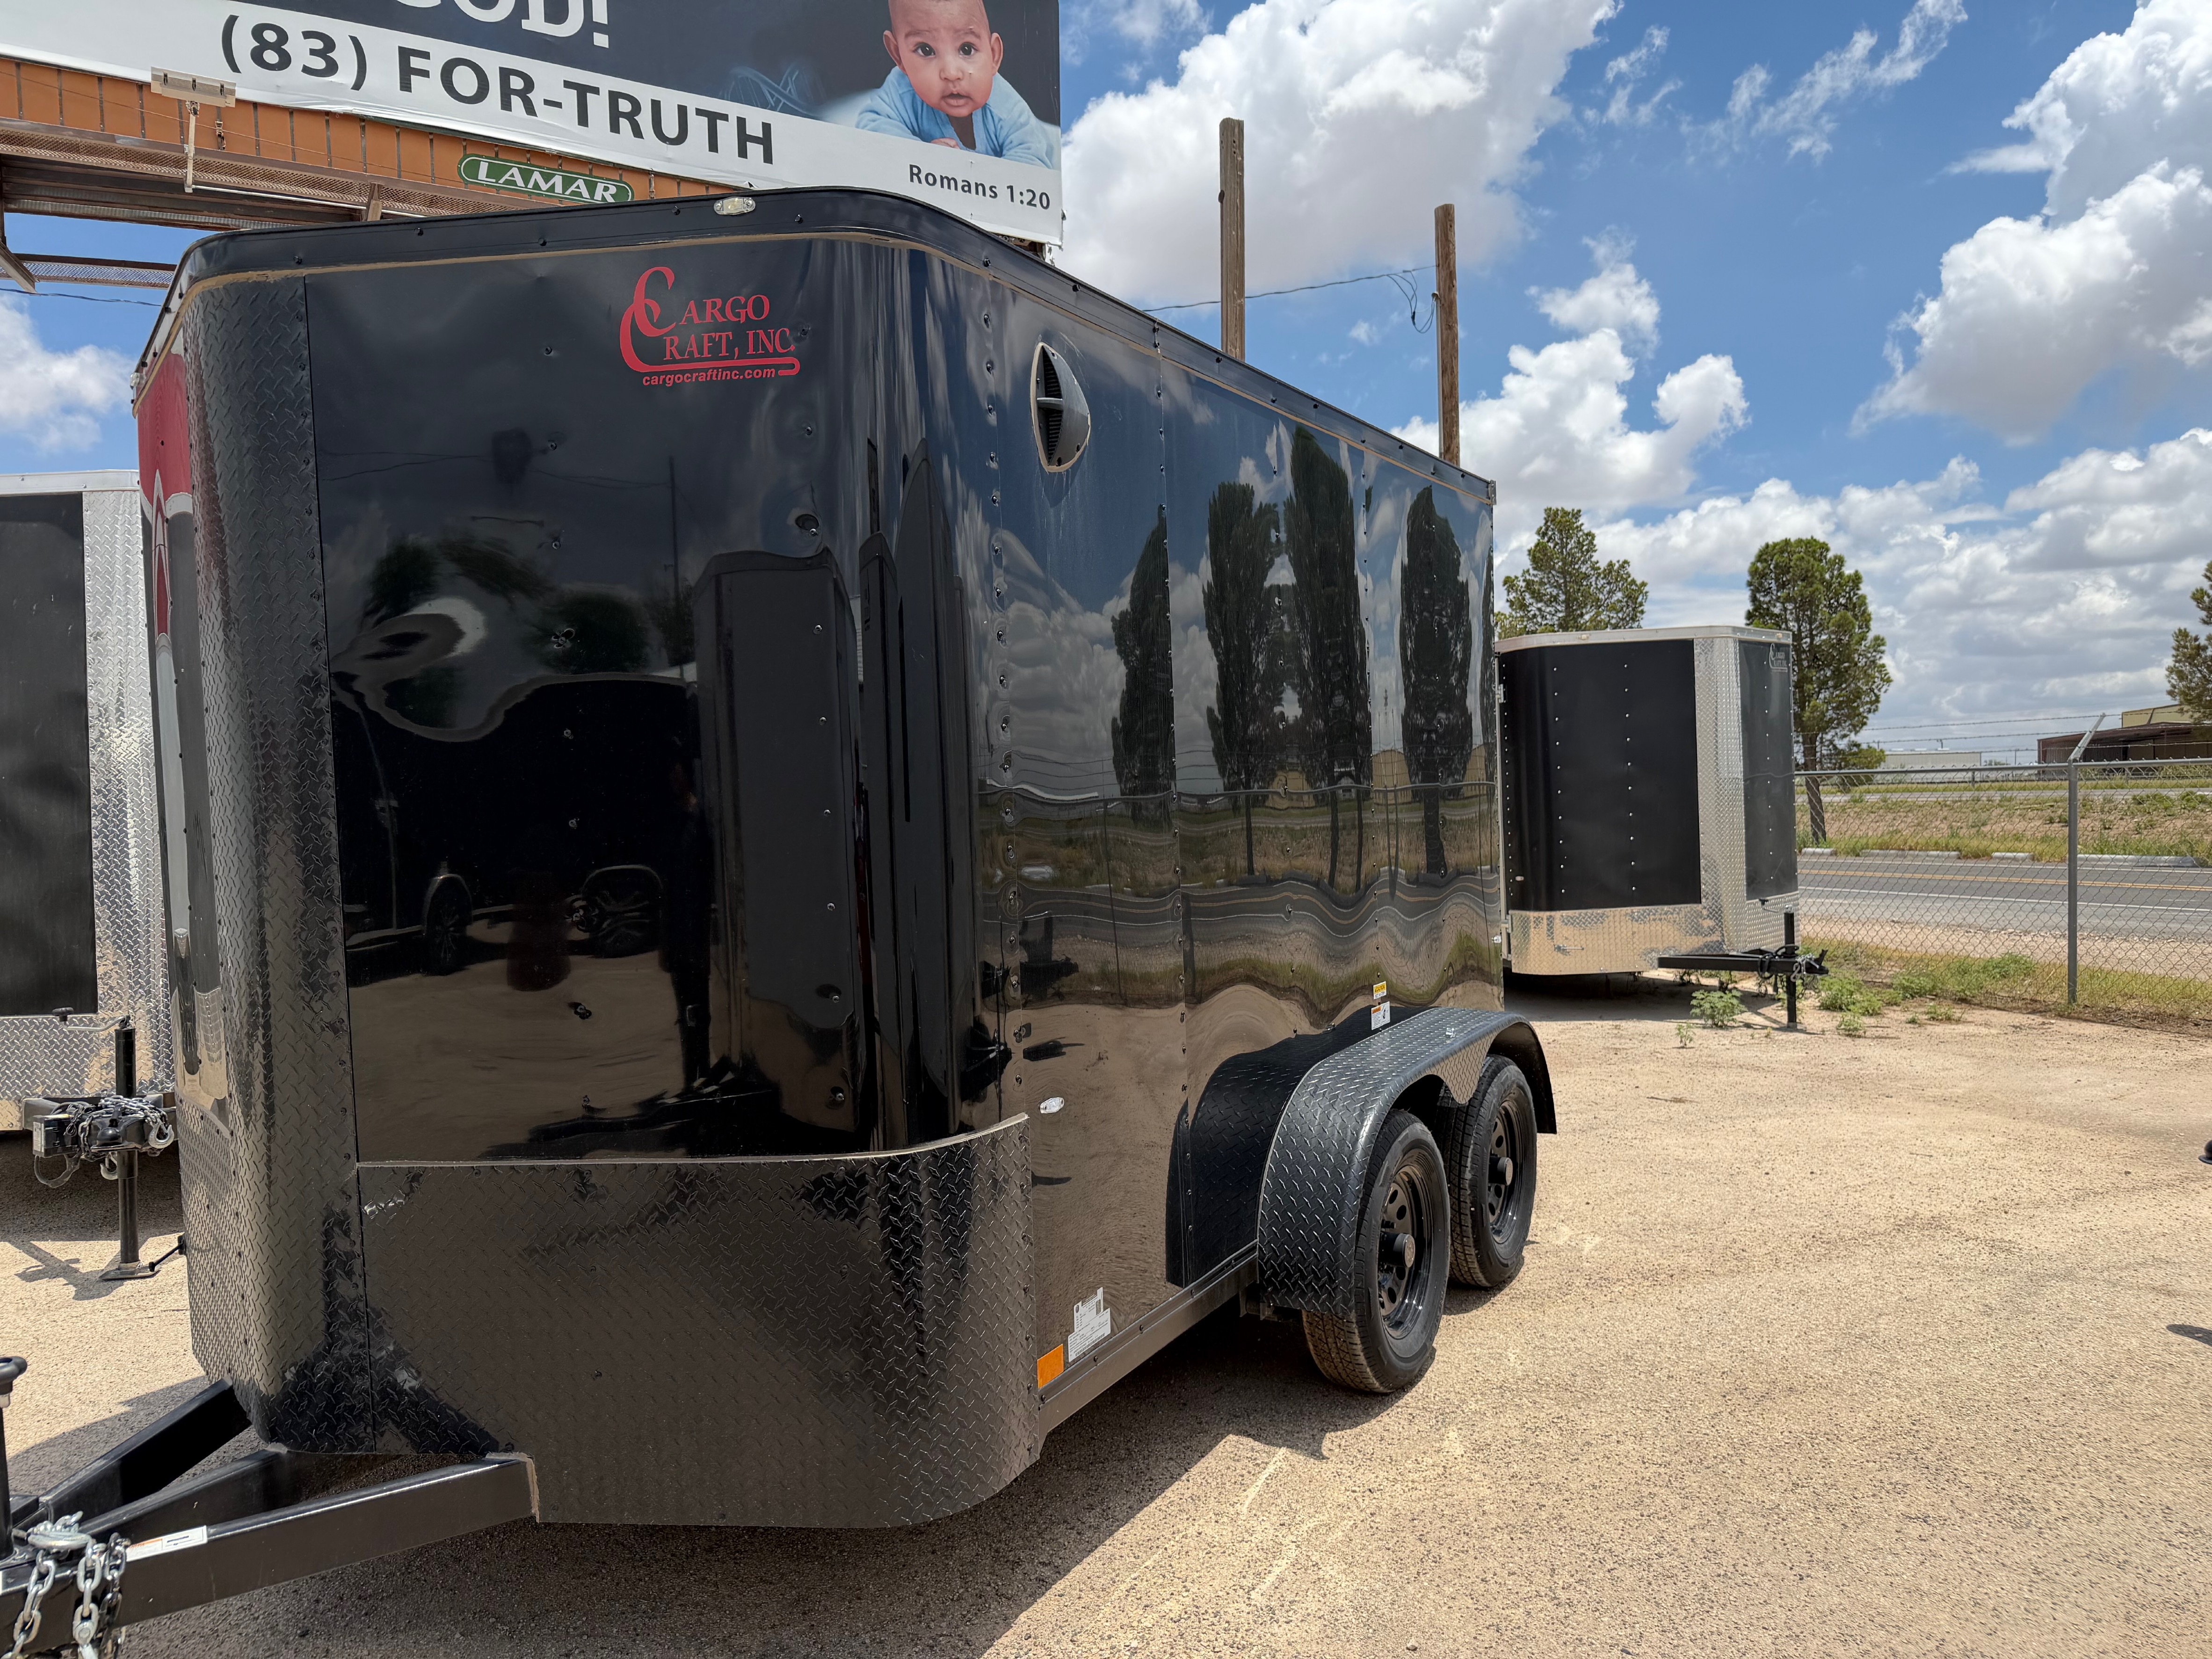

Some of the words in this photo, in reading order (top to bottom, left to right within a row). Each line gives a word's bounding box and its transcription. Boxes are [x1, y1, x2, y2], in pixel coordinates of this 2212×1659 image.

[395, 0, 609, 48] D!
[221, 15, 367, 91] (83)
[398, 45, 773, 165] FOR-TRUTH
[478, 161, 617, 203] LAMAR
[909, 164, 998, 199] Romans
[1006, 185, 1050, 210] 1:20
[633, 266, 770, 337] CARGO
[746, 327, 795, 355] INC.
[642, 368, 776, 387] cargocraftinc.com
